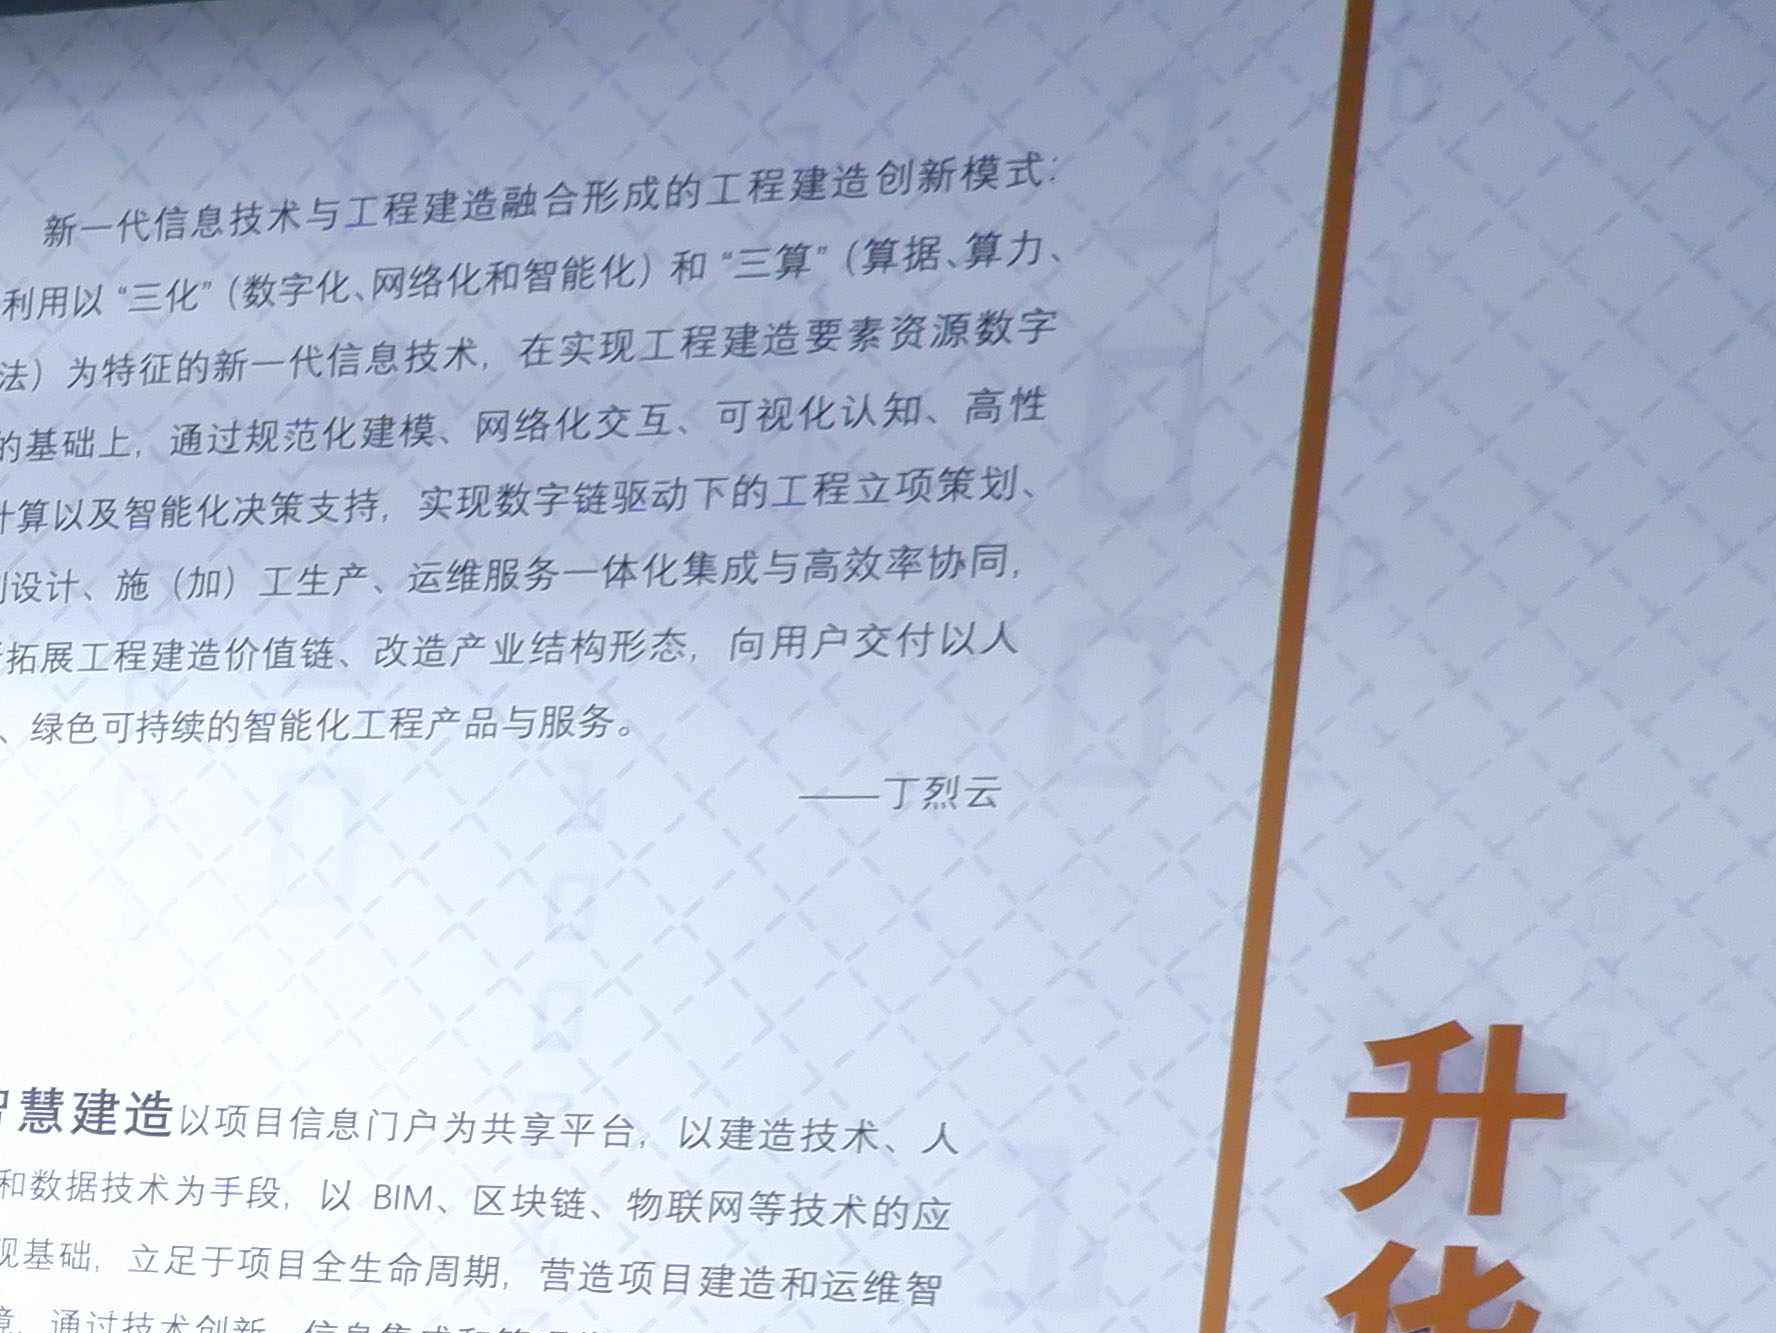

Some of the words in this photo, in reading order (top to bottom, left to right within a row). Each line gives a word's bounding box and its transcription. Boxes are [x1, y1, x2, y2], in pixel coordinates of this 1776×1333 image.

[43, 150, 1059, 249] 新一代信息技术与工程建造融合形成的工程建造创新模式：
